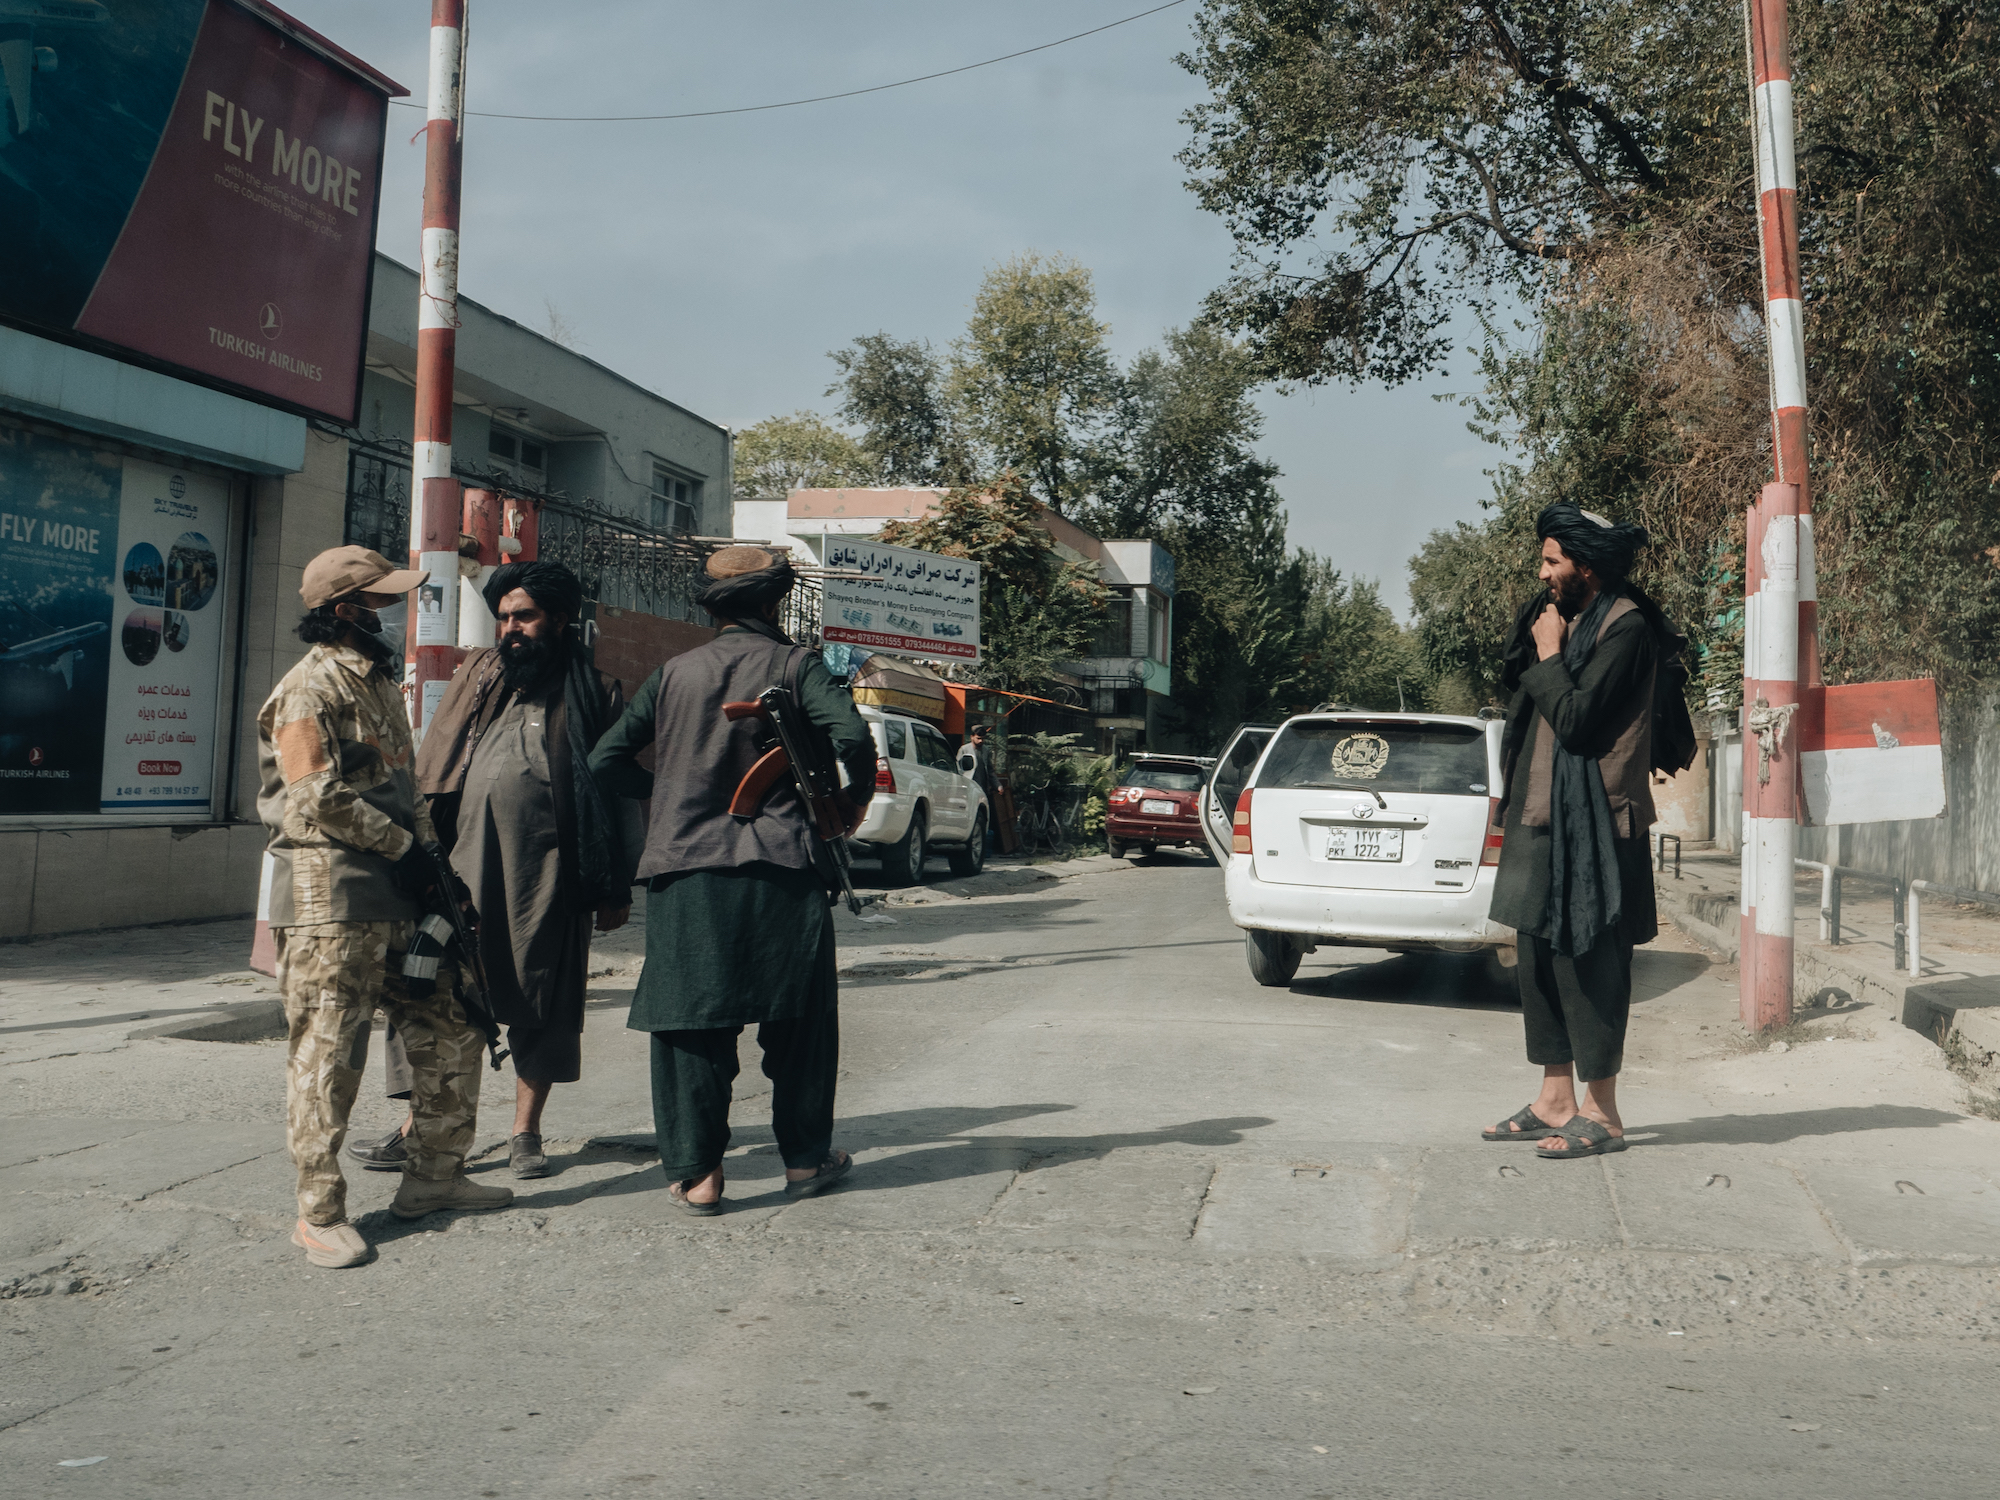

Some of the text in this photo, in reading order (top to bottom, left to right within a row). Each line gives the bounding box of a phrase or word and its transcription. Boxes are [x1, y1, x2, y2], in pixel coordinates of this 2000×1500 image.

[202, 89, 361, 217] FLY MORE
[214, 173, 342, 241] more countries than any other
[224, 162, 337, 226] with the airline that flies to
[208, 326, 323, 383] TURKISH AIRLINES
[0, 512, 100, 555] FLY MORE
[828, 547, 976, 588] شرکت صرافی برادران شایق
[827, 591, 975, 622] Shayeq Brother's Money Exchanging Company
[137, 684, 191, 697] خدمات عمره
[157, 707, 188, 720] خدمات
[125, 730, 197, 746] بسته های تفریحی
[140, 762, 181, 773] Book Now
[1328, 847, 1346, 857] PKY
[1353, 843, 1381, 858] 1272
